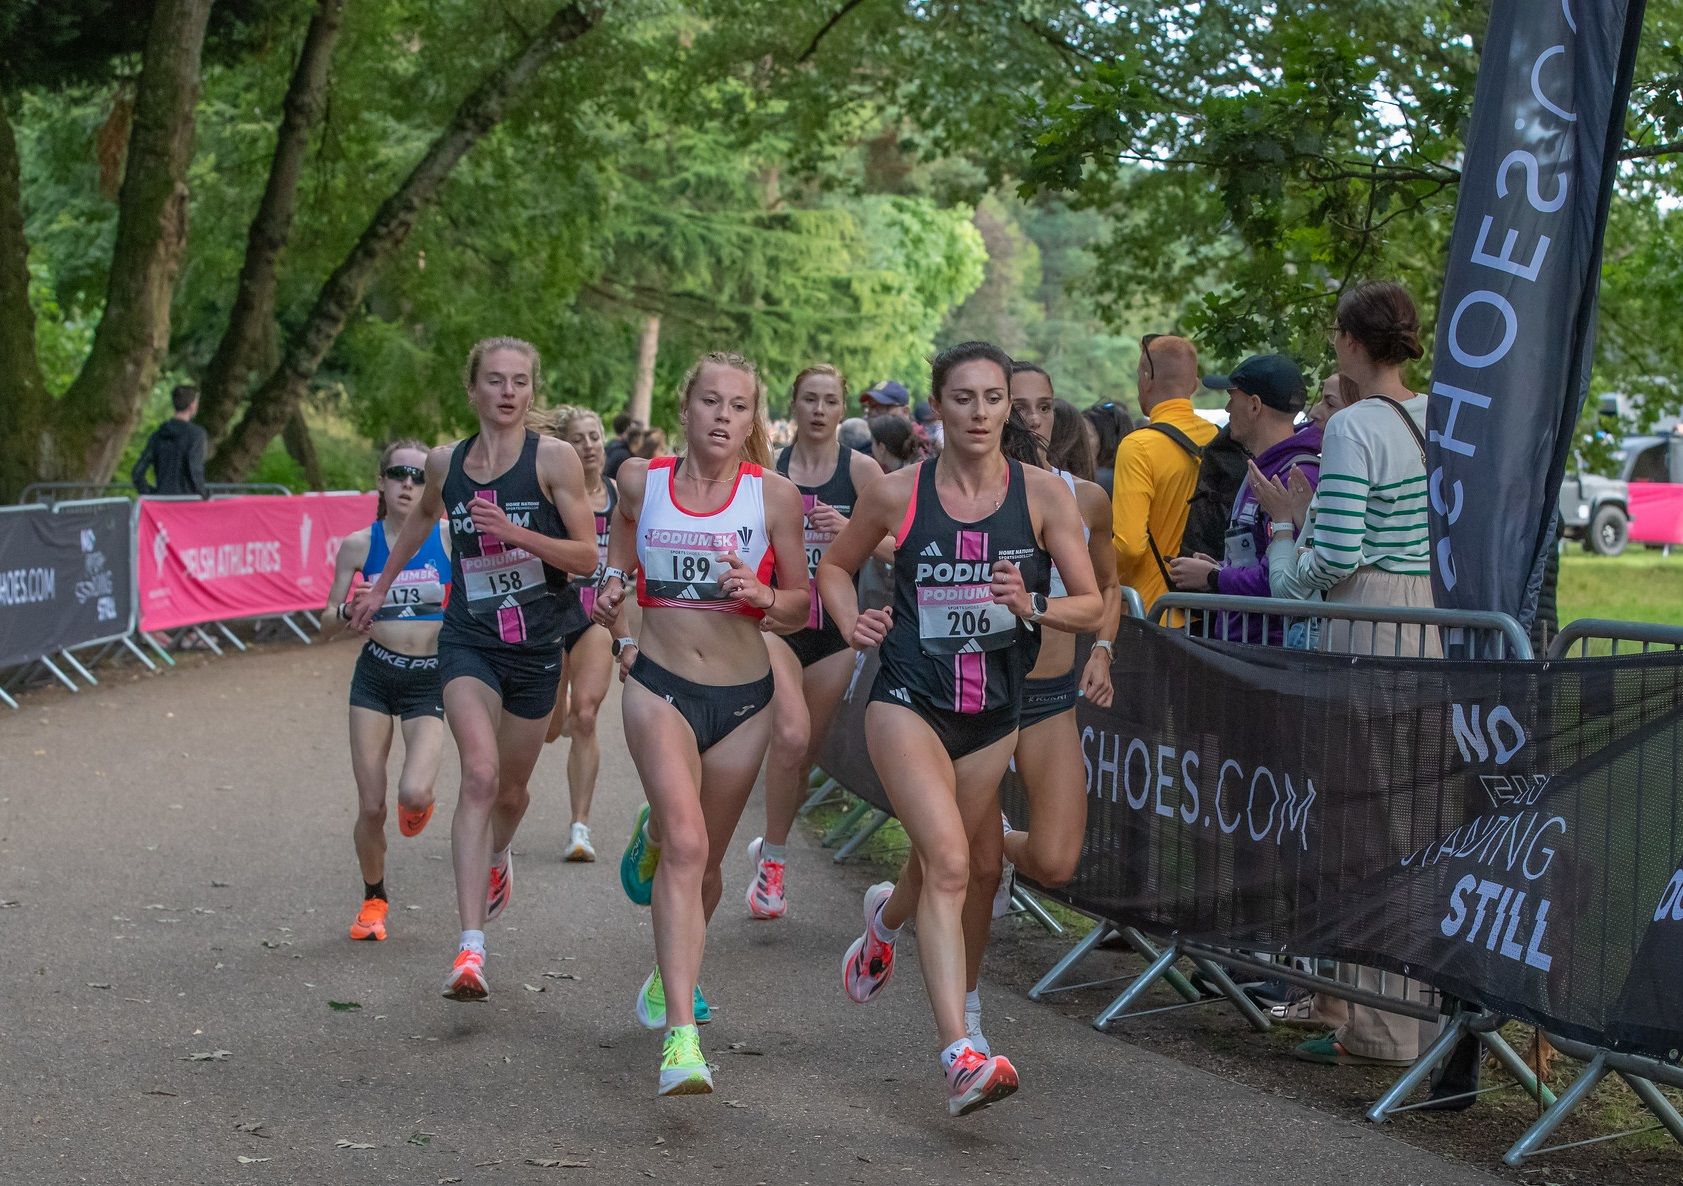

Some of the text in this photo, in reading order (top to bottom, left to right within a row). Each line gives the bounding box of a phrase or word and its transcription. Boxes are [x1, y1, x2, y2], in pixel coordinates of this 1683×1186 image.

[672, 556, 711, 581] 189
[917, 562, 1020, 582] PODIU
[488, 570, 523, 595] 158
[392, 588, 420, 604] 173
[947, 609, 991, 635] 206
[368, 643, 439, 669] NIKE PR
[1452, 703, 1526, 764] NO
[1441, 874, 1552, 972] STILL
